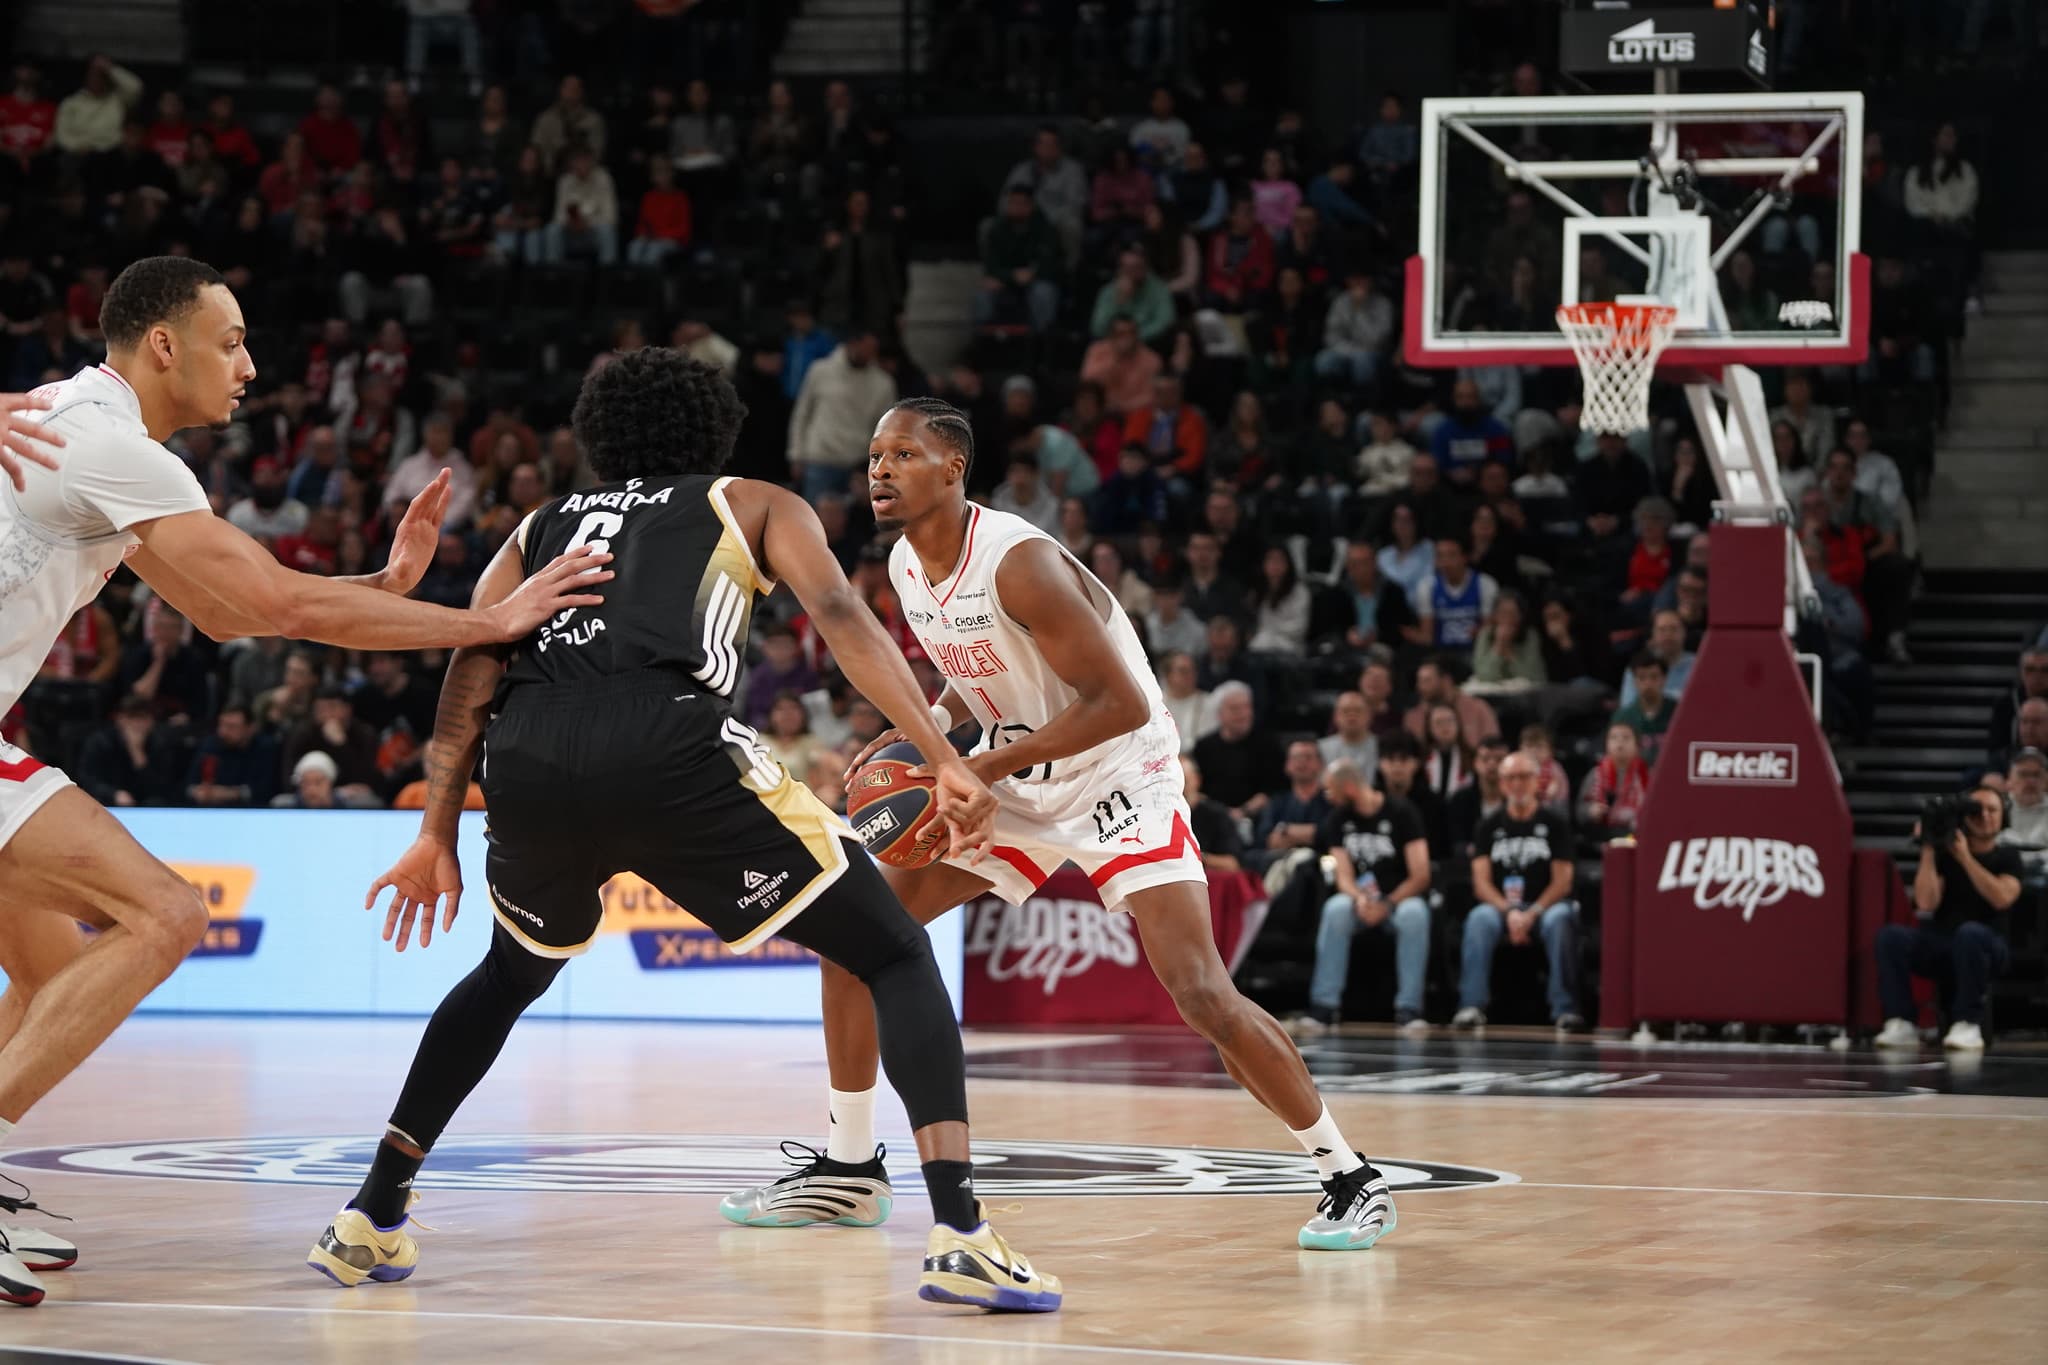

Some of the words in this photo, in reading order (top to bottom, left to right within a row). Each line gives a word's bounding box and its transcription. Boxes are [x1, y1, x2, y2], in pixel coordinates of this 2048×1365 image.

[1608, 39, 1695, 62] LOTUS
[563, 511, 624, 575] 6
[924, 637, 1009, 679] CHOLET
[971, 686, 1003, 721] 1
[1697, 751, 1789, 779] Betclic
[1098, 812, 1140, 844] CHOLET
[1657, 837, 1825, 898] LEADERS
[760, 889, 781, 909] BTP
[1694, 864, 1791, 923] Cup
[985, 928, 1098, 996] Cup
